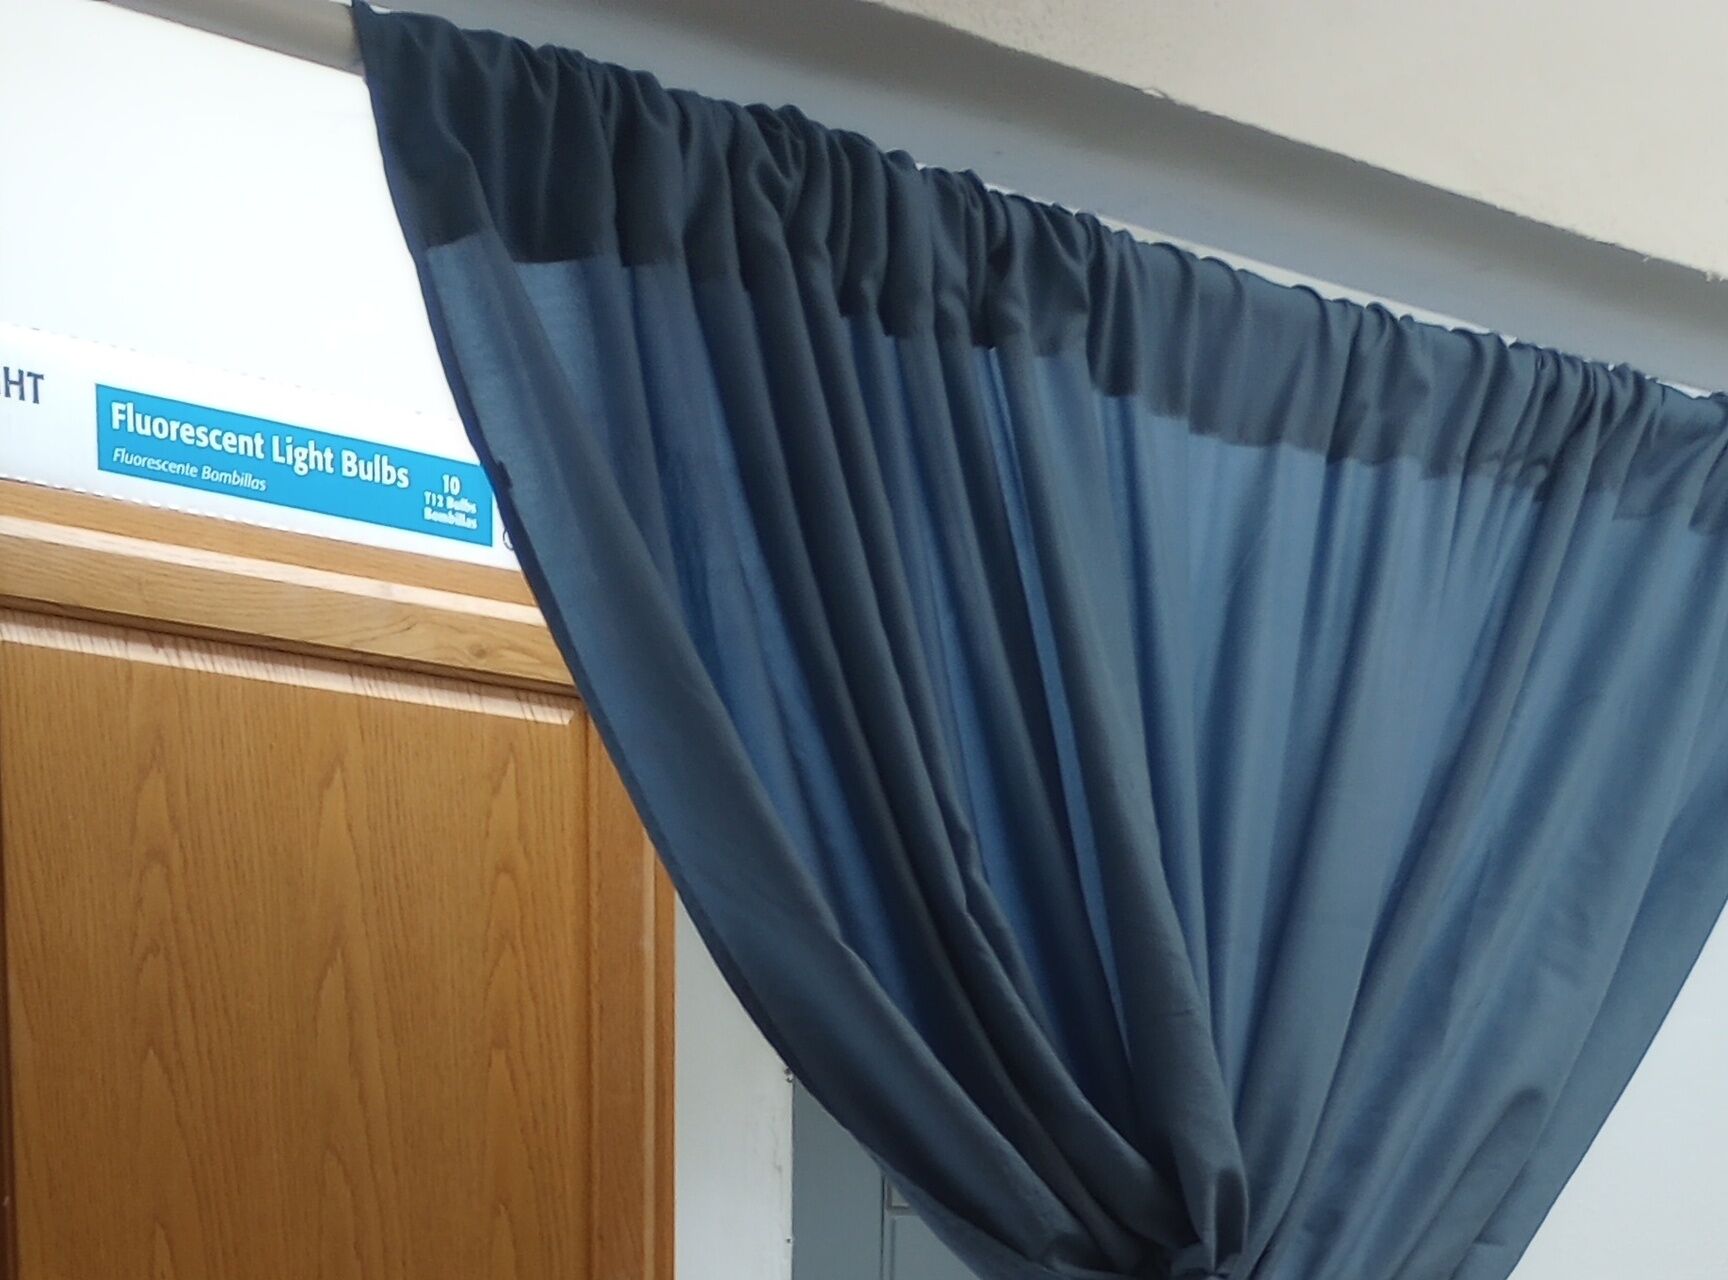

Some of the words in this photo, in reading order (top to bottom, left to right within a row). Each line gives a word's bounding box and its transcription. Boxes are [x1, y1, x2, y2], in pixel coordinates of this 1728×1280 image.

[111, 401, 265, 460] Fluorescent
[271, 435, 335, 476] Light
[341, 449, 410, 489] Bulbs
[113, 447, 199, 477] Fluorescente
[201, 465, 267, 491] Bombillas
[442, 473, 461, 496] 10
